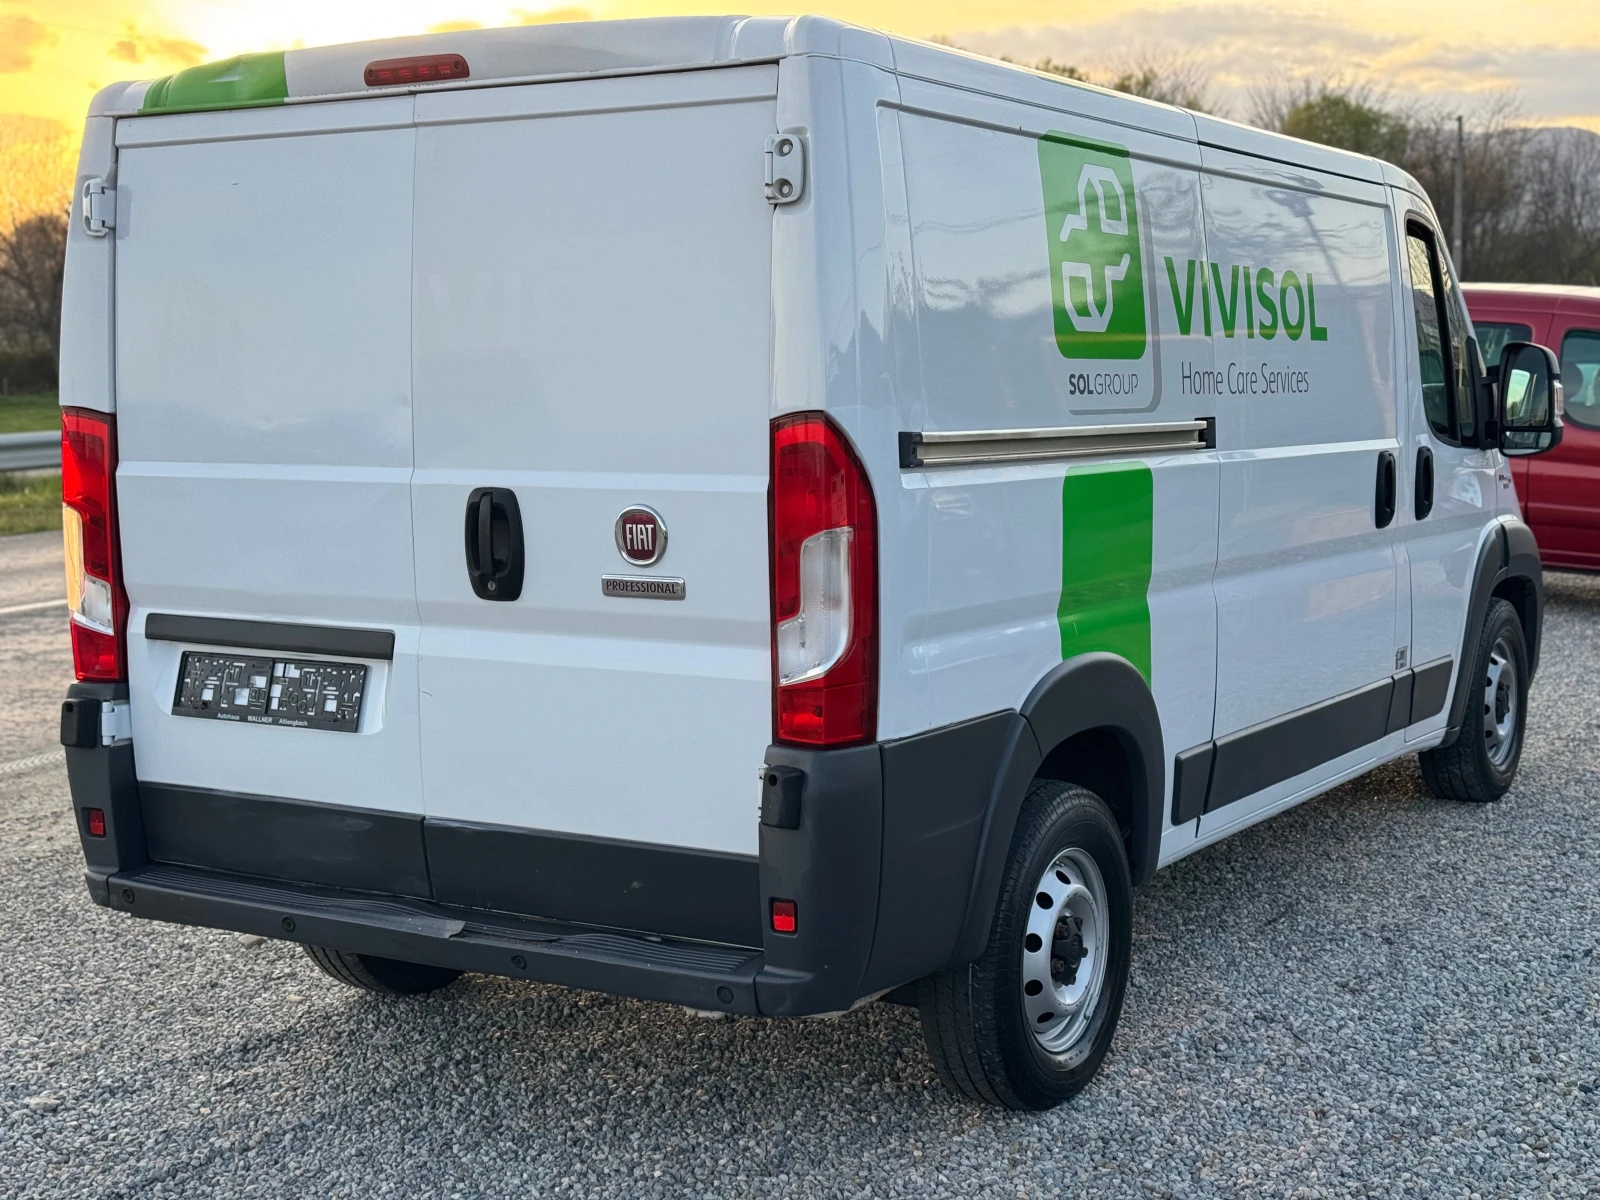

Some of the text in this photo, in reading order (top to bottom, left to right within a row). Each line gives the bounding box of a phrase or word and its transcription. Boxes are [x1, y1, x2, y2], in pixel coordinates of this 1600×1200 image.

[1164, 256, 1328, 341] VIVISOL
[1068, 373, 1139, 395] SOLGROUP
[1181, 361, 1309, 394] Home Care Services
[625, 523, 654, 550] FIAT
[606, 580, 677, 594] PROFESSIONAL
[217, 712, 240, 721] Autohaus
[247, 715, 273, 724] WALLNER
